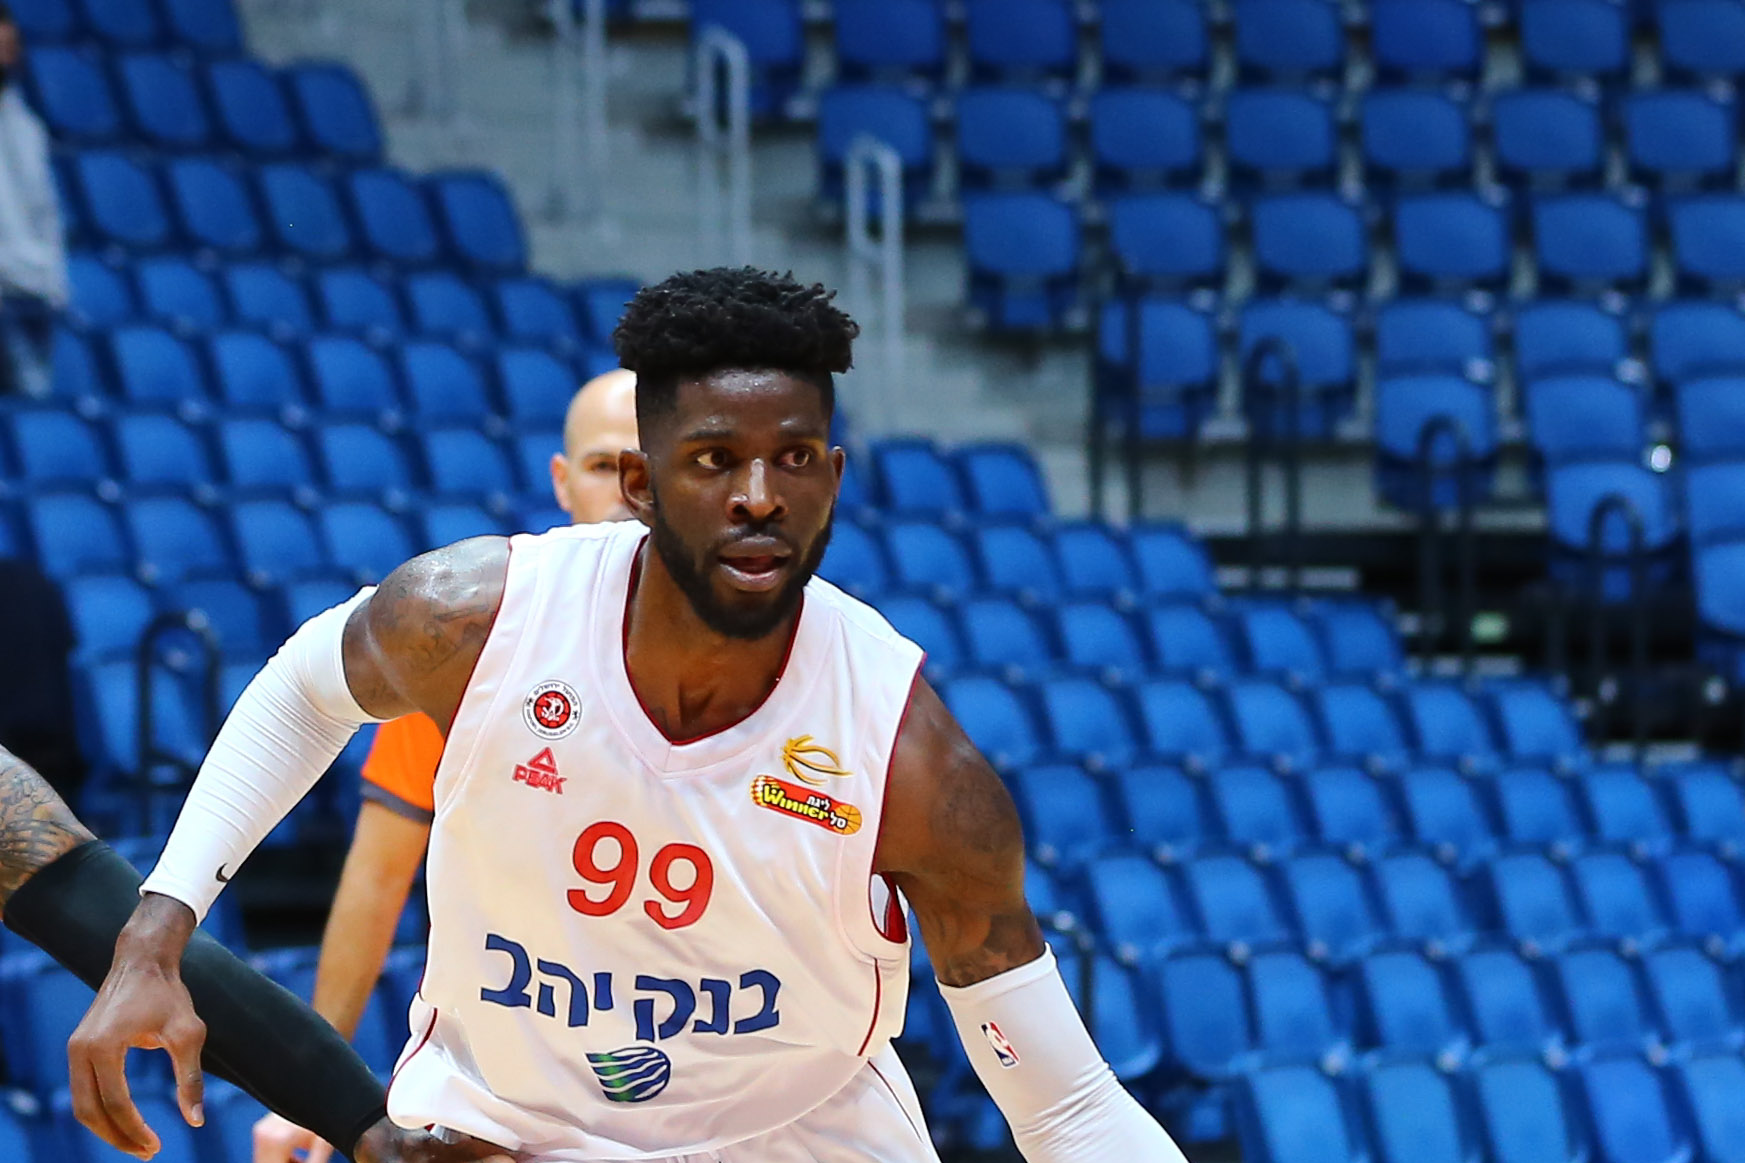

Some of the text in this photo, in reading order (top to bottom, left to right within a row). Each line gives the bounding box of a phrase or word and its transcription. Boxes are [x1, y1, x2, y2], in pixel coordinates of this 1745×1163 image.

[512, 764, 568, 795] PEAK
[763, 784, 829, 820] Winner
[806, 796, 830, 810] ליגת
[830, 812, 847, 828] סל
[567, 821, 714, 930] 99
[479, 933, 782, 1043] בנק יהב
